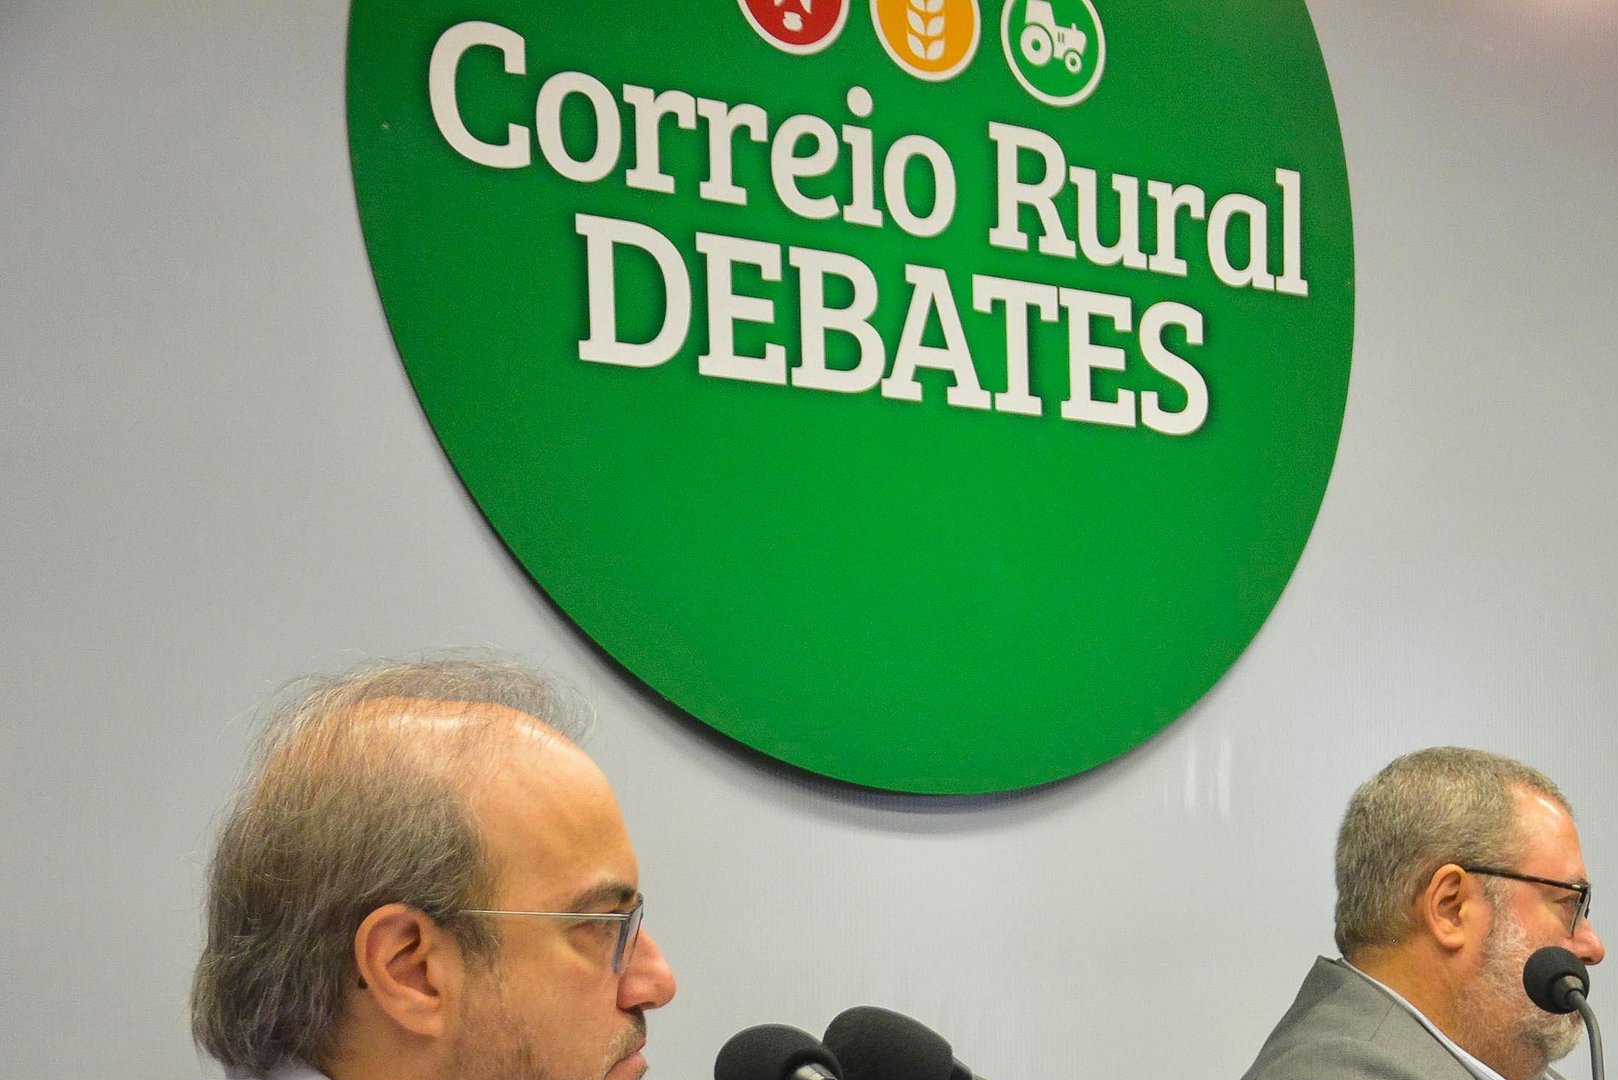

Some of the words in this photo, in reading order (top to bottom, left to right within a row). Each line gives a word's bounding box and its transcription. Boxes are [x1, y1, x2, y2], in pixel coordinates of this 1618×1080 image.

[428, 20, 957, 237] Correio
[987, 121, 1309, 297] Rural
[575, 213, 1209, 436] DEBATES
